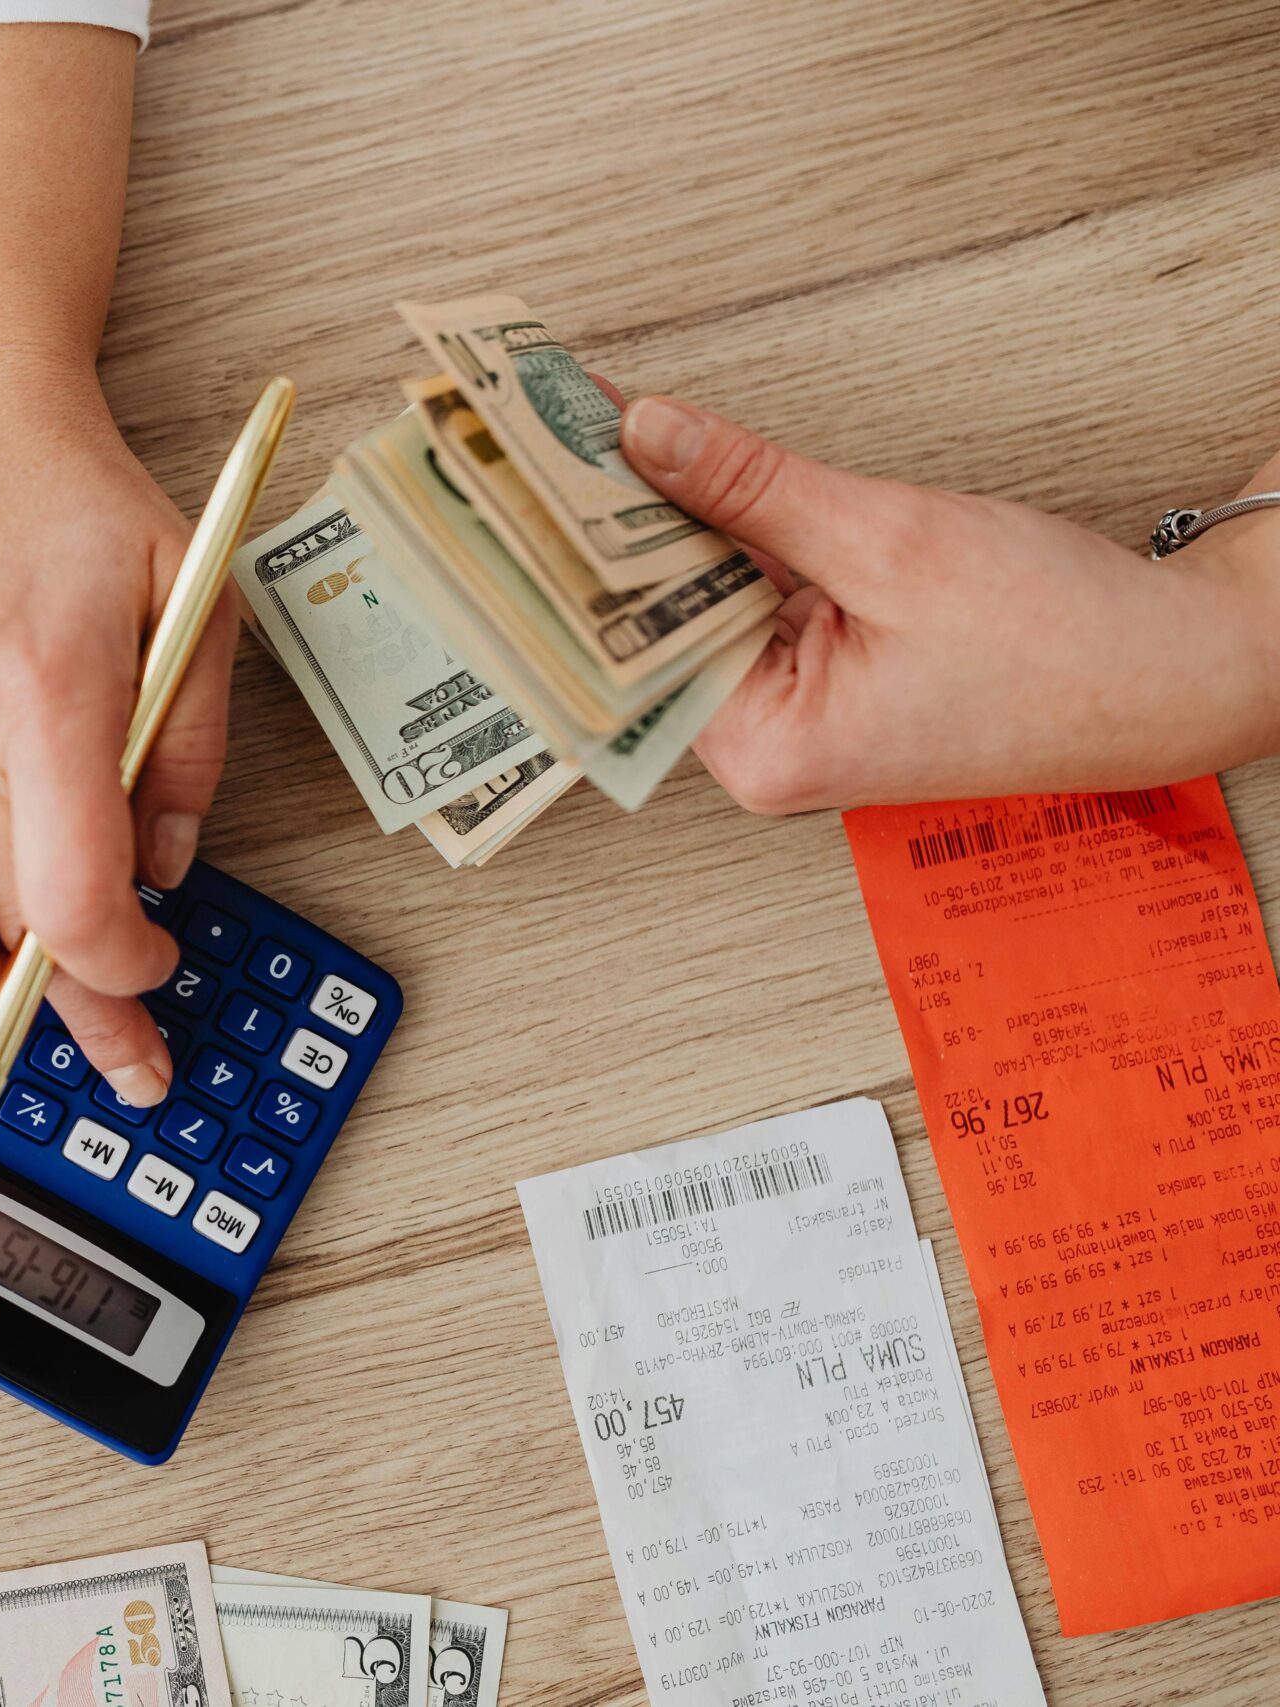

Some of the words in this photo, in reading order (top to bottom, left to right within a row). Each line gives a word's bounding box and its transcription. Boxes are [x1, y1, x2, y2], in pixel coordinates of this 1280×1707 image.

[361, 588, 379, 609] N
[381, 747, 462, 806] 20
[1009, 866, 1043, 885] dnia
[924, 875, 1003, 906] 2019-06-01
[943, 882, 1064, 920] nieuszkodzonego
[1137, 886, 1219, 916] pracownika
[1200, 902, 1248, 923] Kasjer
[1149, 927, 1228, 958] transakcji
[269, 953, 293, 980] 0
[909, 952, 940, 973] 0987
[1196, 960, 1264, 988] Płatność
[175, 970, 202, 998] 2
[911, 968, 961, 990] Patryk
[919, 991, 951, 1012] 5817
[241, 1008, 259, 1033] 1
[1006, 1002, 1088, 1032] MasterCard
[49, 1042, 76, 1071] 9
[299, 1045, 335, 1075] CE
[1219, 1037, 1280, 1075] SUMA
[212, 1062, 235, 1086] 4
[1155, 1055, 1208, 1092] PLN
[943, 1087, 984, 1109] 13:22
[1204, 1085, 1230, 1103] PTU
[950, 1091, 1049, 1139] 267,96
[1186, 1104, 1236, 1128] 23,00%
[179, 1117, 206, 1144] 7
[79, 1136, 115, 1165] M+
[976, 1133, 1017, 1155] 50,11
[1168, 1135, 1195, 1153] PTU
[982, 1153, 1023, 1176] 50,11
[847, 1176, 884, 1196] Numer
[986, 1171, 1037, 1196] 267,96
[1156, 1174, 1206, 1196] damska
[868, 1194, 889, 1213] Nr
[1210, 1201, 1277, 1228] Wielopak
[205, 1206, 247, 1239] MRC
[788, 1202, 865, 1231] transakcji
[847, 1215, 892, 1237] Kasjer
[1162, 1217, 1204, 1239] majek
[646, 1217, 718, 1246] TA:150551
[1004, 1232, 1046, 1255] 99,99
[1052, 1221, 1094, 1244] 99,99
[681, 1236, 723, 1259] 95060
[1057, 1228, 1157, 1264] bawełnianych
[1016, 1272, 1057, 1295] 59,99
[1064, 1261, 1105, 1284] 59,99
[657, 1296, 739, 1328] MASTERCARD
[747, 1308, 771, 1326] BGI
[1072, 1300, 1114, 1324] 27,99
[579, 1324, 624, 1348] 457,00
[675, 1317, 739, 1345] 15492676
[862, 1334, 925, 1372] SUMA
[1082, 1341, 1125, 1363] 79,99
[1200, 1331, 1261, 1358] PARAGON
[1034, 1352, 1076, 1374] 79,99
[1129, 1346, 1195, 1375] FISKALNY
[795, 1356, 847, 1390] PLN
[874, 1366, 933, 1392] Podatek
[587, 1388, 626, 1409] 14:02
[843, 1382, 869, 1401] PTU
[896, 1387, 939, 1406] Kwota
[1031, 1384, 1119, 1419] wydr.209857
[1143, 1378, 1249, 1416] 701-01-80-987
[594, 1393, 684, 1441] 457,00
[824, 1402, 874, 1426] 23,00%
[1179, 1407, 1213, 1428] Łódź
[1220, 1394, 1273, 1419] 93-570
[888, 1407, 945, 1432] Sprzed.
[1243, 1414, 1277, 1432] Jana
[806, 1434, 832, 1452] PTU
[839, 1422, 879, 1444] opod.
[1194, 1423, 1238, 1445] Pawła
[616, 1435, 656, 1457] 85,46
[1145, 1440, 1164, 1458] 30
[1201, 1448, 1229, 1468] 253
[1234, 1444, 1251, 1460] 42
[622, 1455, 661, 1477] 85,46
[1152, 1461, 1171, 1478] 90
[1176, 1456, 1195, 1473] 30
[627, 1474, 672, 1500] 457,00
[1078, 1476, 1105, 1495] 253
[1112, 1468, 1146, 1486] Tel:
[1183, 1465, 1253, 1490] Warszawa
[801, 1497, 841, 1520] PASEK
[884, 1493, 949, 1521] 10002626
[1190, 1498, 1208, 1514] 19
[641, 1537, 688, 1560] 179,00
[785, 1538, 851, 1566] KOSZULKA
[895, 1534, 960, 1560] 10001596
[653, 1577, 700, 1602] 149,00
[796, 1581, 864, 1608] KOSZULKA
[825, 1596, 885, 1623] PARAGON
[913, 1590, 995, 1624] 2020-06-10
[123, 1598, 164, 1669] 50
[664, 1617, 711, 1643] 129,00
[755, 1611, 820, 1641] FISKALNY
[752, 1646, 768, 1660] nr
[880, 1635, 904, 1653] NIP
[341, 1634, 405, 1685] 5
[660, 1651, 743, 1691] wydr.030719
[767, 1645, 870, 1682] 107-000-93-37
[876, 1653, 918, 1673] Mysia
[802, 1670, 853, 1696] 00-496
[913, 1662, 972, 1686] Massimo
[866, 1678, 907, 1702] Dutti
